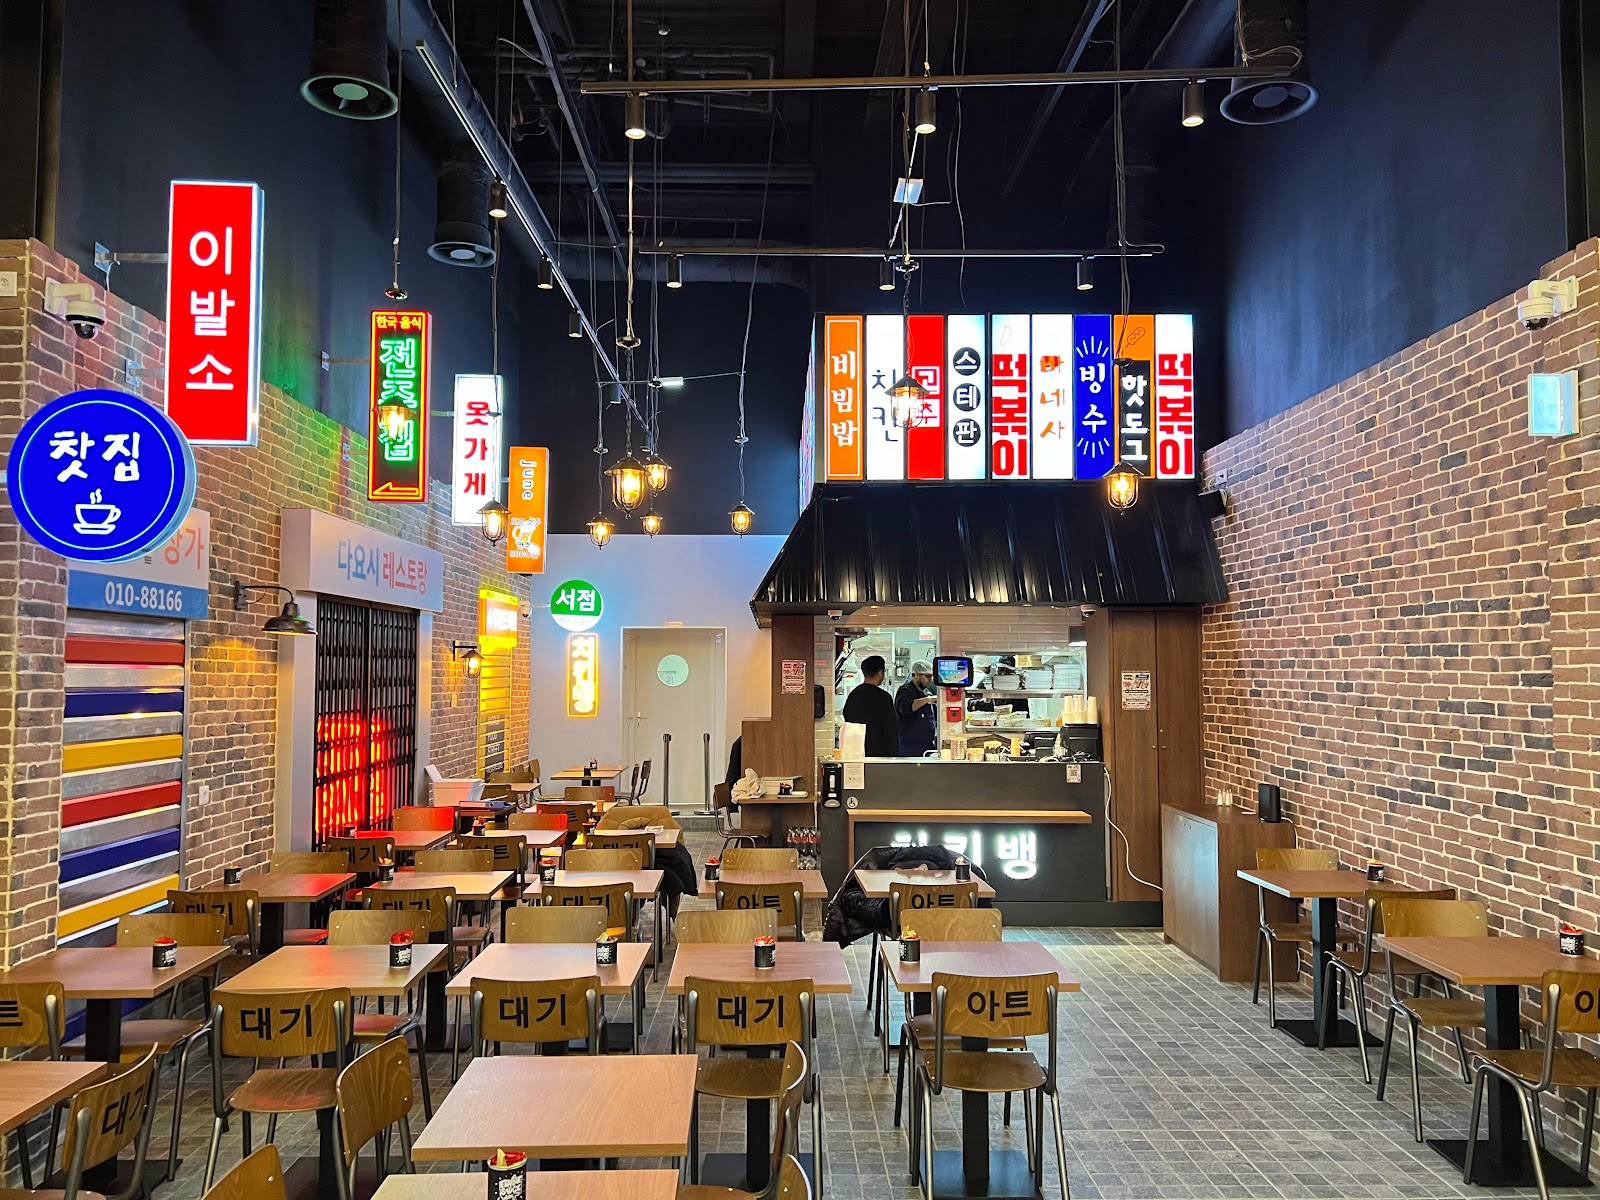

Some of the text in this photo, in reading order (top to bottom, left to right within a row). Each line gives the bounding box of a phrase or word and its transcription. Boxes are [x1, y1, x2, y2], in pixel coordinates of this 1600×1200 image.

[186, 226, 236, 392] 이발소
[376, 314, 422, 330] 한국 음식
[831, 349, 858, 447] 비빔밥
[954, 350, 979, 444] 스테판
[992, 353, 1028, 477] 떡볶이
[1078, 362, 1108, 435] 빙수
[1120, 374, 1150, 462] 핫도그
[1159, 353, 1195, 476] 떡볶이
[49, 430, 141, 483] 찻집
[519, 459, 537, 501] june
[337, 538, 379, 588] 다요시
[382, 551, 428, 597] 레스토랑
[104, 580, 183, 613] 010-88166
[555, 588, 596, 612] 서점
[240, 1003, 313, 1041] 대기
[499, 994, 568, 1029] 대기
[718, 995, 785, 1030] 대기
[967, 990, 1032, 1022] 아트
[101, 1080, 149, 1136] 대기
